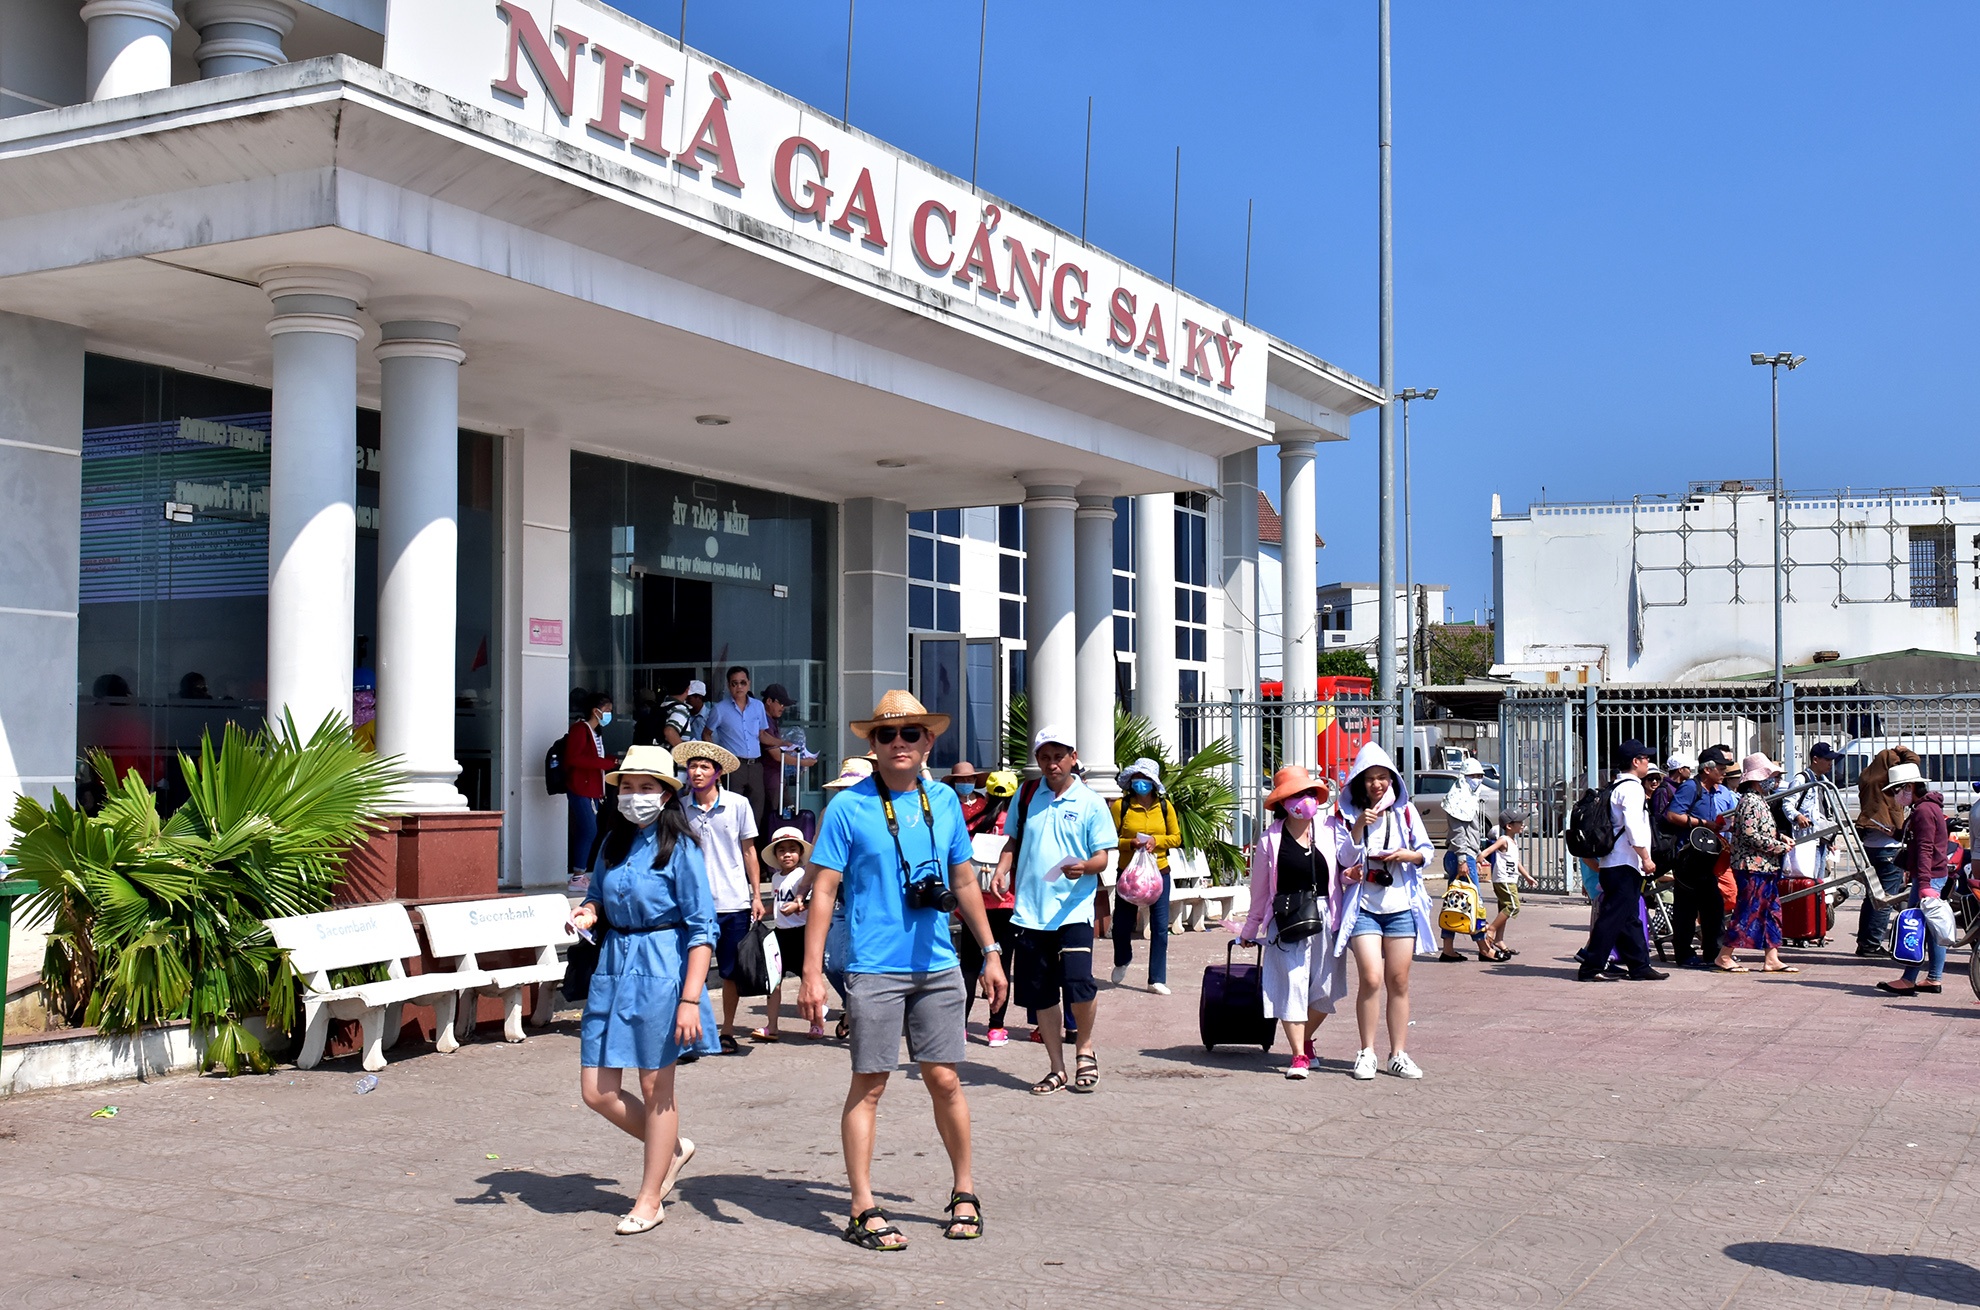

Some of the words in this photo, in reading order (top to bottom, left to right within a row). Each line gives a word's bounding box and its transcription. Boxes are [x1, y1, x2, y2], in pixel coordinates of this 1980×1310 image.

[491, 3, 745, 189] NHÀ
[771, 136, 888, 248] GA
[912, 199, 1091, 329] CẢNG
[1107, 287, 1169, 363] SA
[1181, 318, 1243, 390] KỲ
[469, 905, 535, 926] Sacombank
[315, 916, 378, 940] Sacombank
